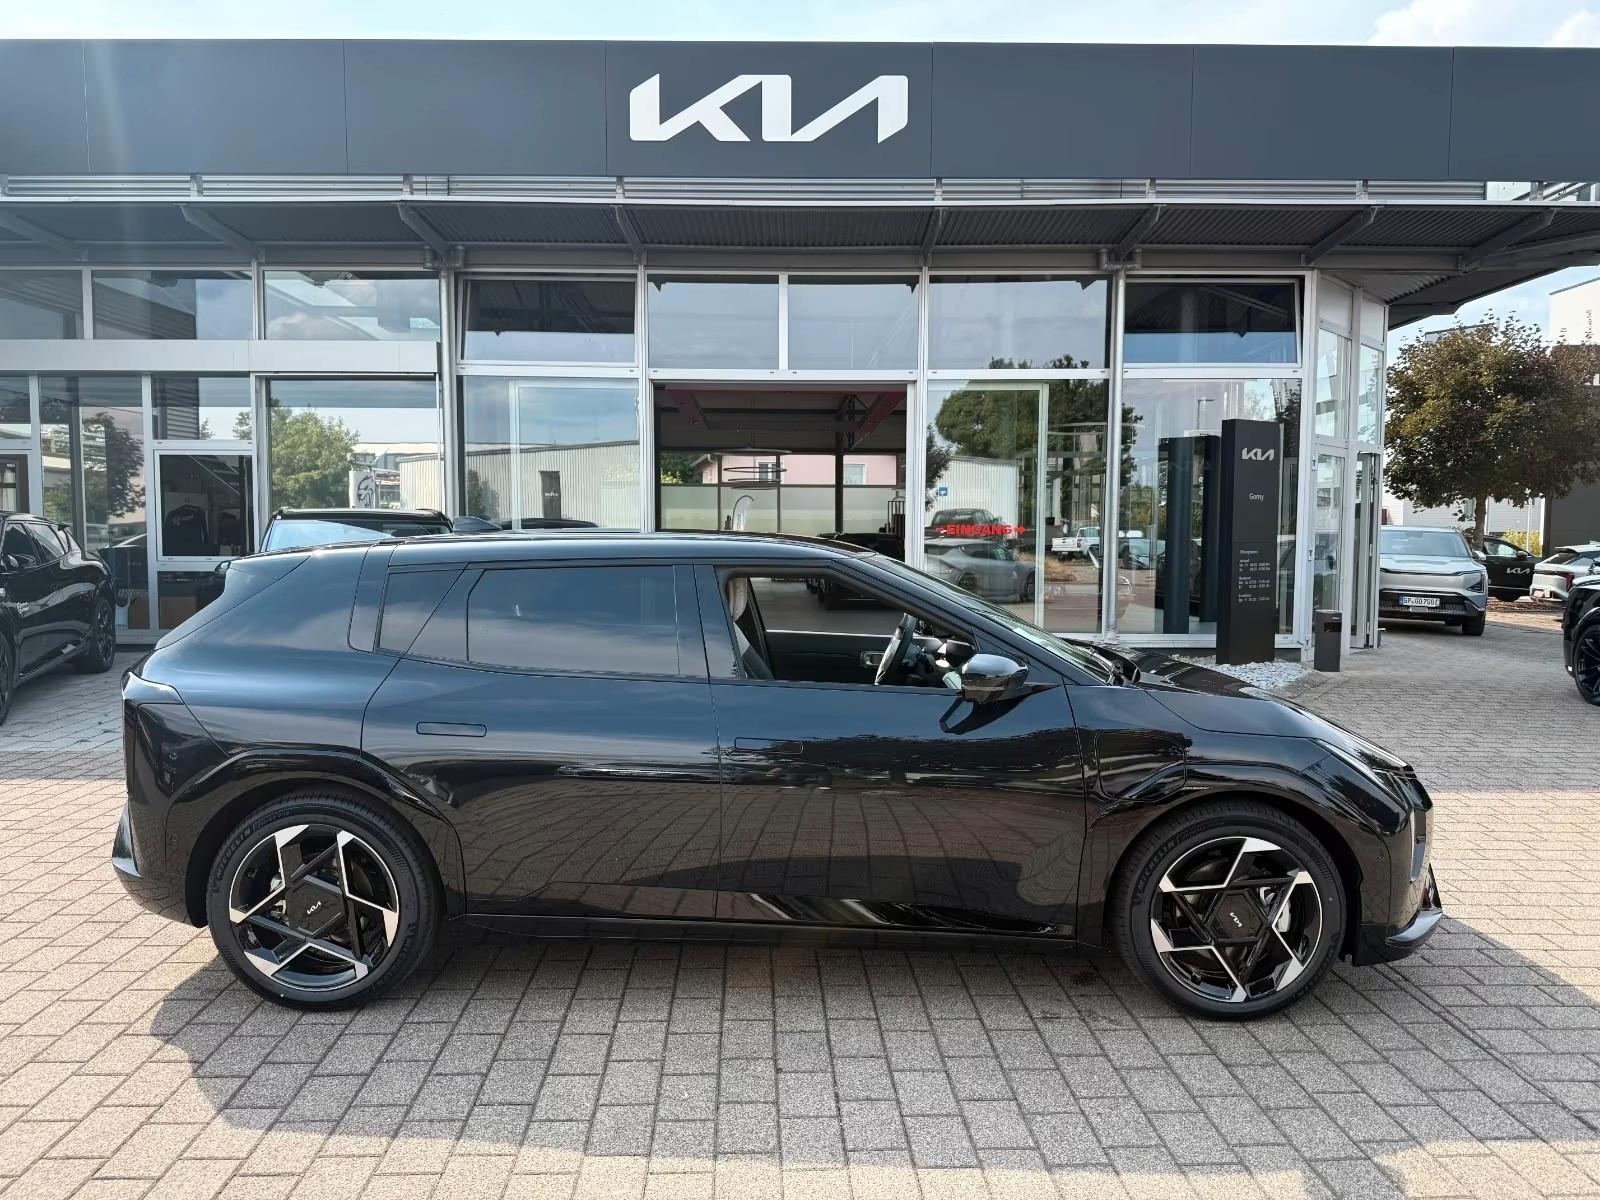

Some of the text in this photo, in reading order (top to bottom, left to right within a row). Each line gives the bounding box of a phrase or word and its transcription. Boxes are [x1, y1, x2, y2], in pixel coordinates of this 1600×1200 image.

[629, 73, 908, 144] KIA
[1241, 447, 1275, 462] KIA
[946, 523, 1012, 536] EINGANG
[1506, 567, 1530, 575] KIA
